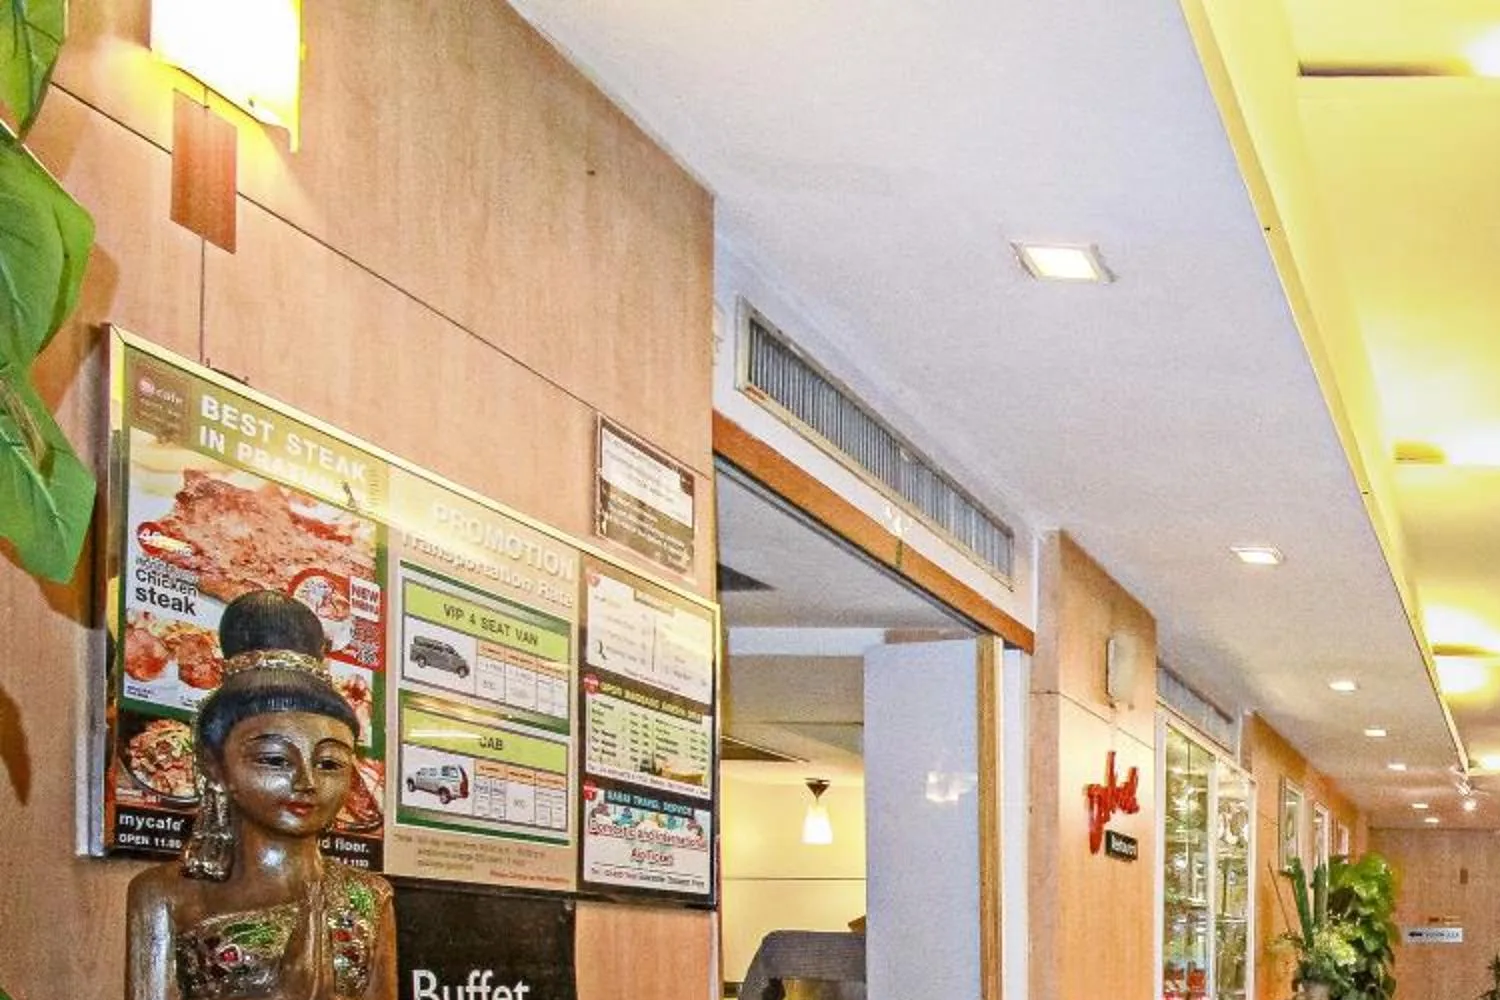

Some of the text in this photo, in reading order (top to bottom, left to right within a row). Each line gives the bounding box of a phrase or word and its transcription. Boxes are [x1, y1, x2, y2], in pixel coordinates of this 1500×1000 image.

[200, 395, 273, 442] BEST
[287, 431, 367, 479] STEAK
[200, 425, 225, 454] IN
[433, 503, 575, 582] PROMOTION
[135, 586, 197, 616] steak
[443, 604, 539, 647] VIP 4 SEAT VAN
[119, 833, 149, 845] OPEN
